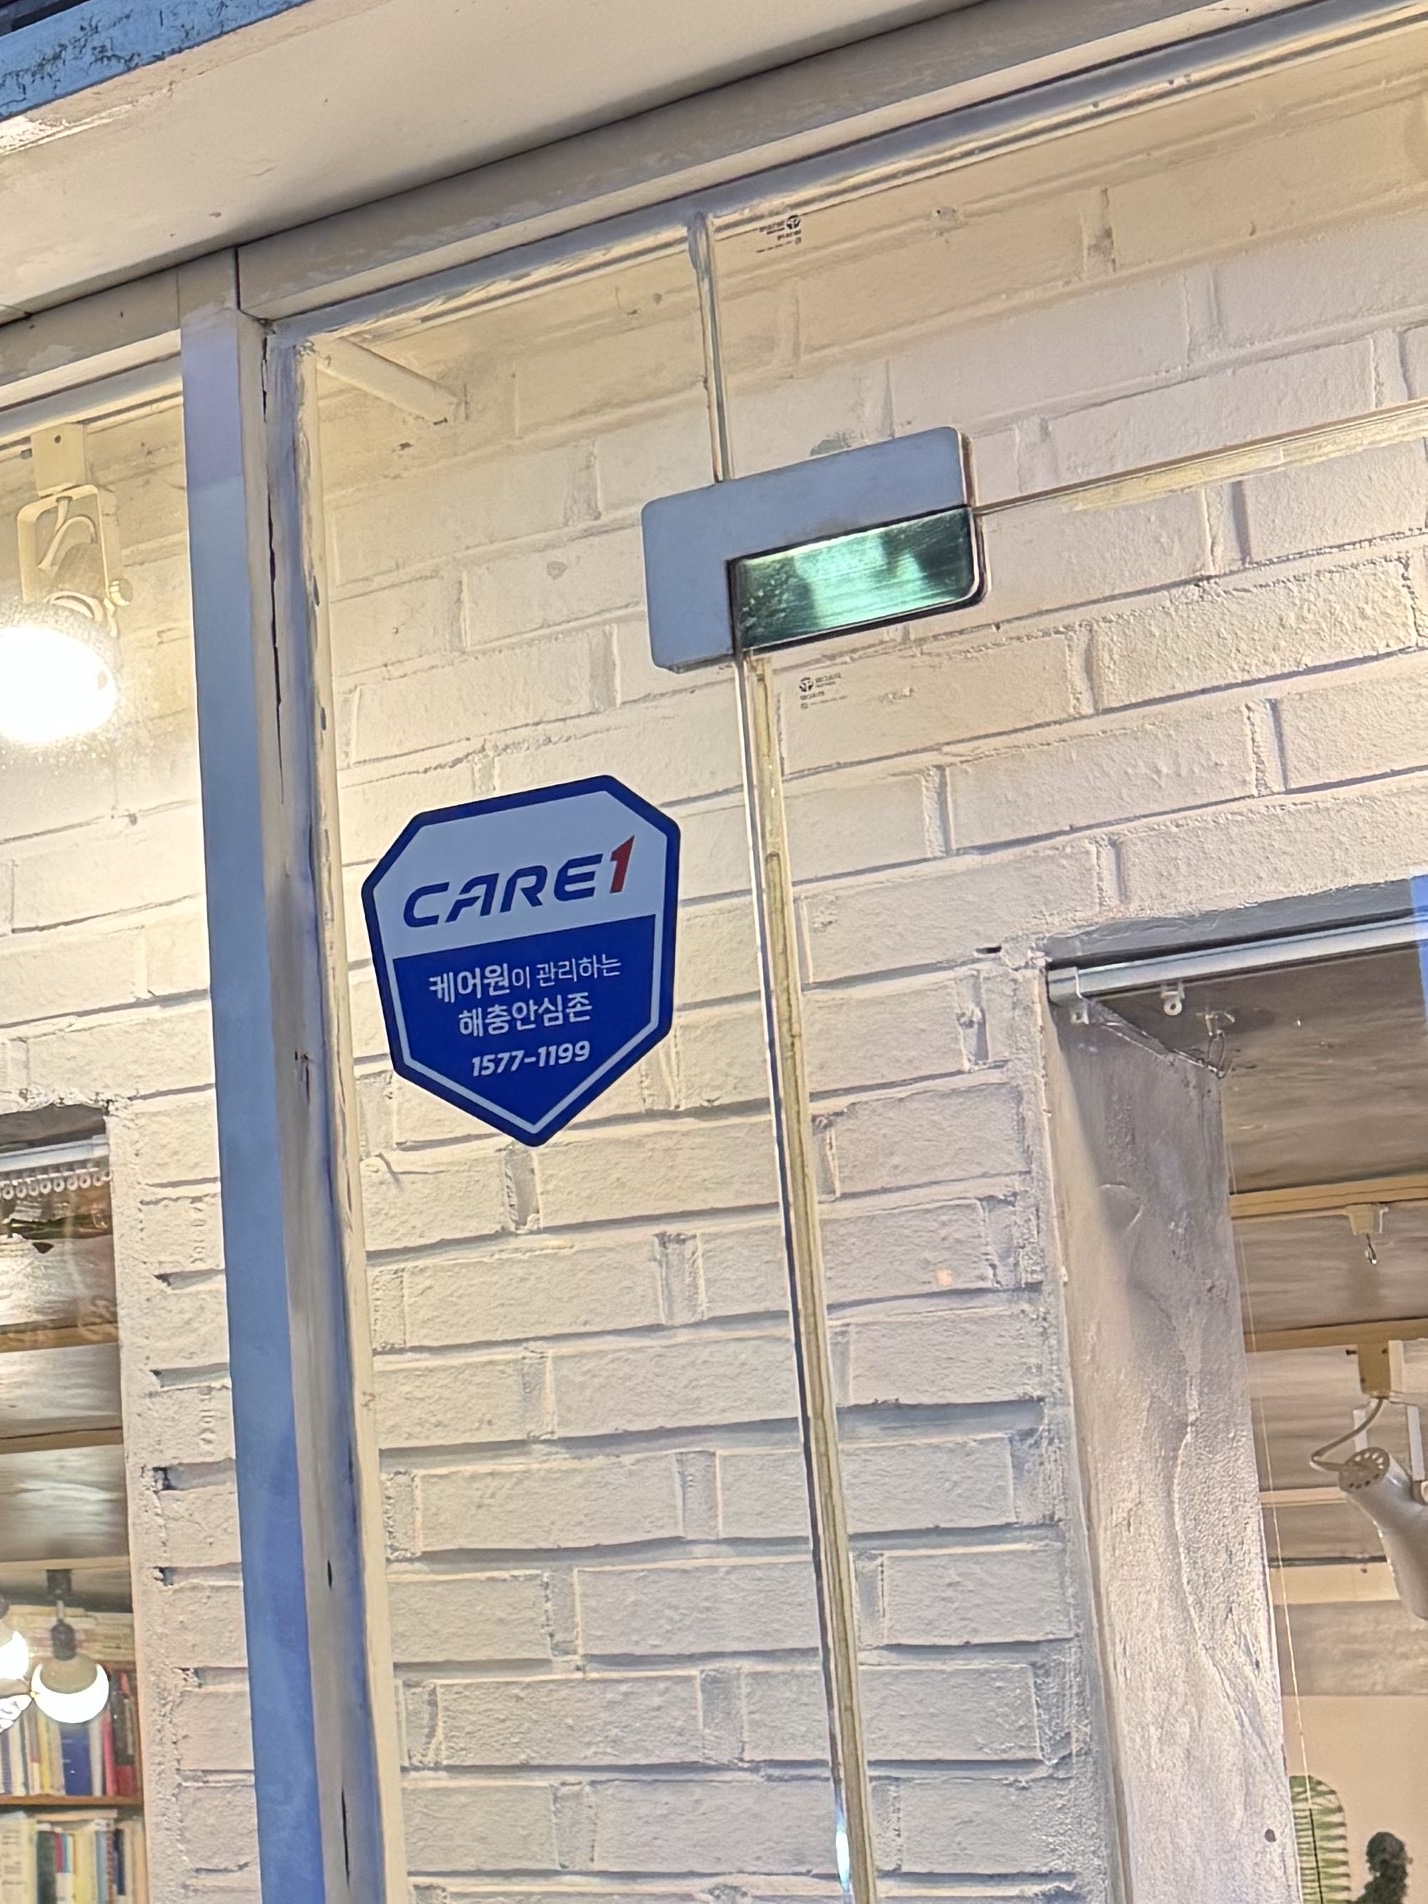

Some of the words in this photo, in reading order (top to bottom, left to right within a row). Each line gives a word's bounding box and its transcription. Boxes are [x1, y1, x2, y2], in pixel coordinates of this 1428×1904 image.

[403, 835, 635, 928] CARE1
[429, 961, 531, 1004] 케어원이
[535, 953, 622, 988] 관리하는
[457, 991, 593, 1038] 해충안심존
[470, 1040, 591, 1078] 1577-1199
